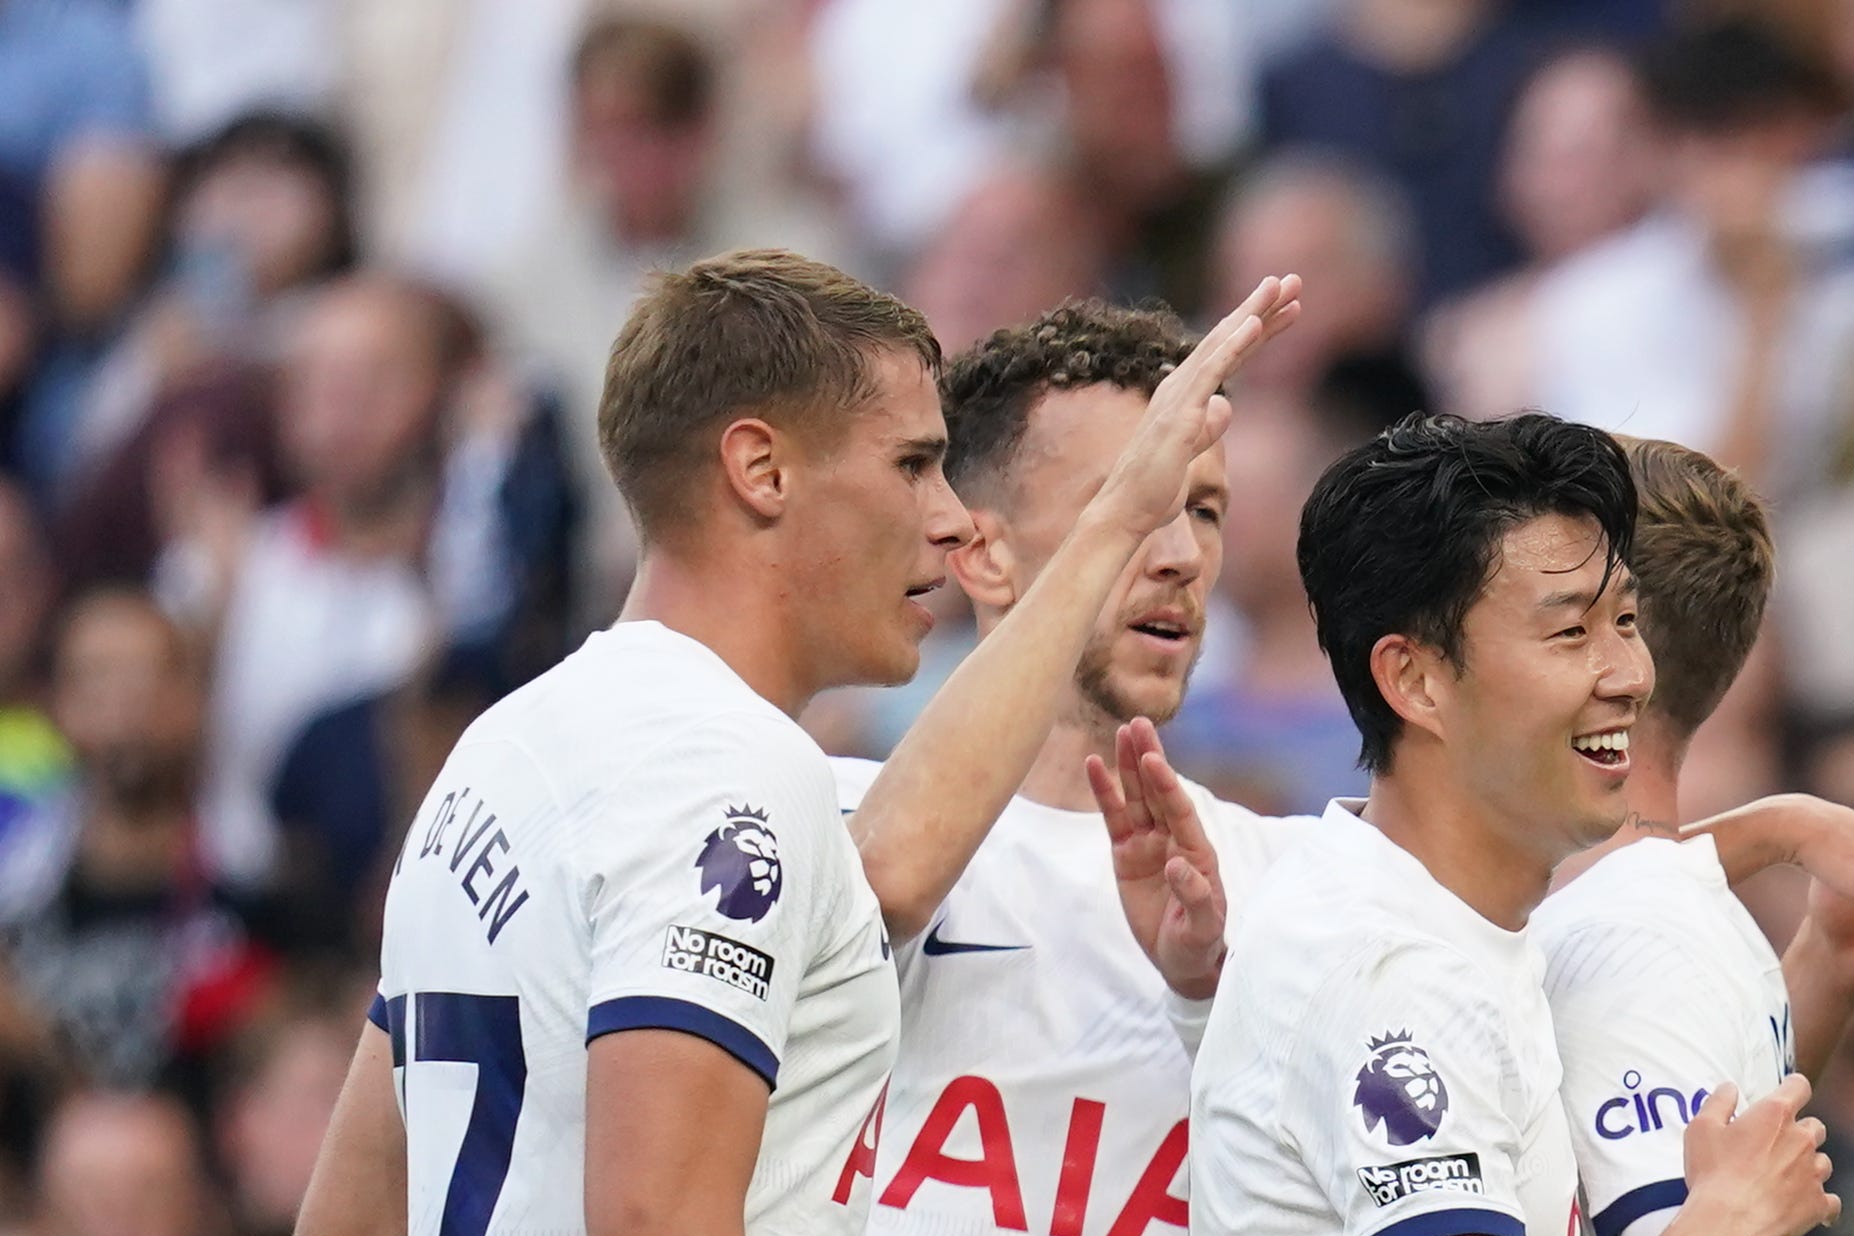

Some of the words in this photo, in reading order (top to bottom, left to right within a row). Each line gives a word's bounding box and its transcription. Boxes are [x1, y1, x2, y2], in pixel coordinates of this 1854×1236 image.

[449, 799, 530, 946] VEN
[663, 946, 702, 972] for
[703, 957, 769, 1001] racism
[666, 926, 705, 953] No
[708, 938, 767, 977] room
[1400, 1159, 1469, 1184] room
